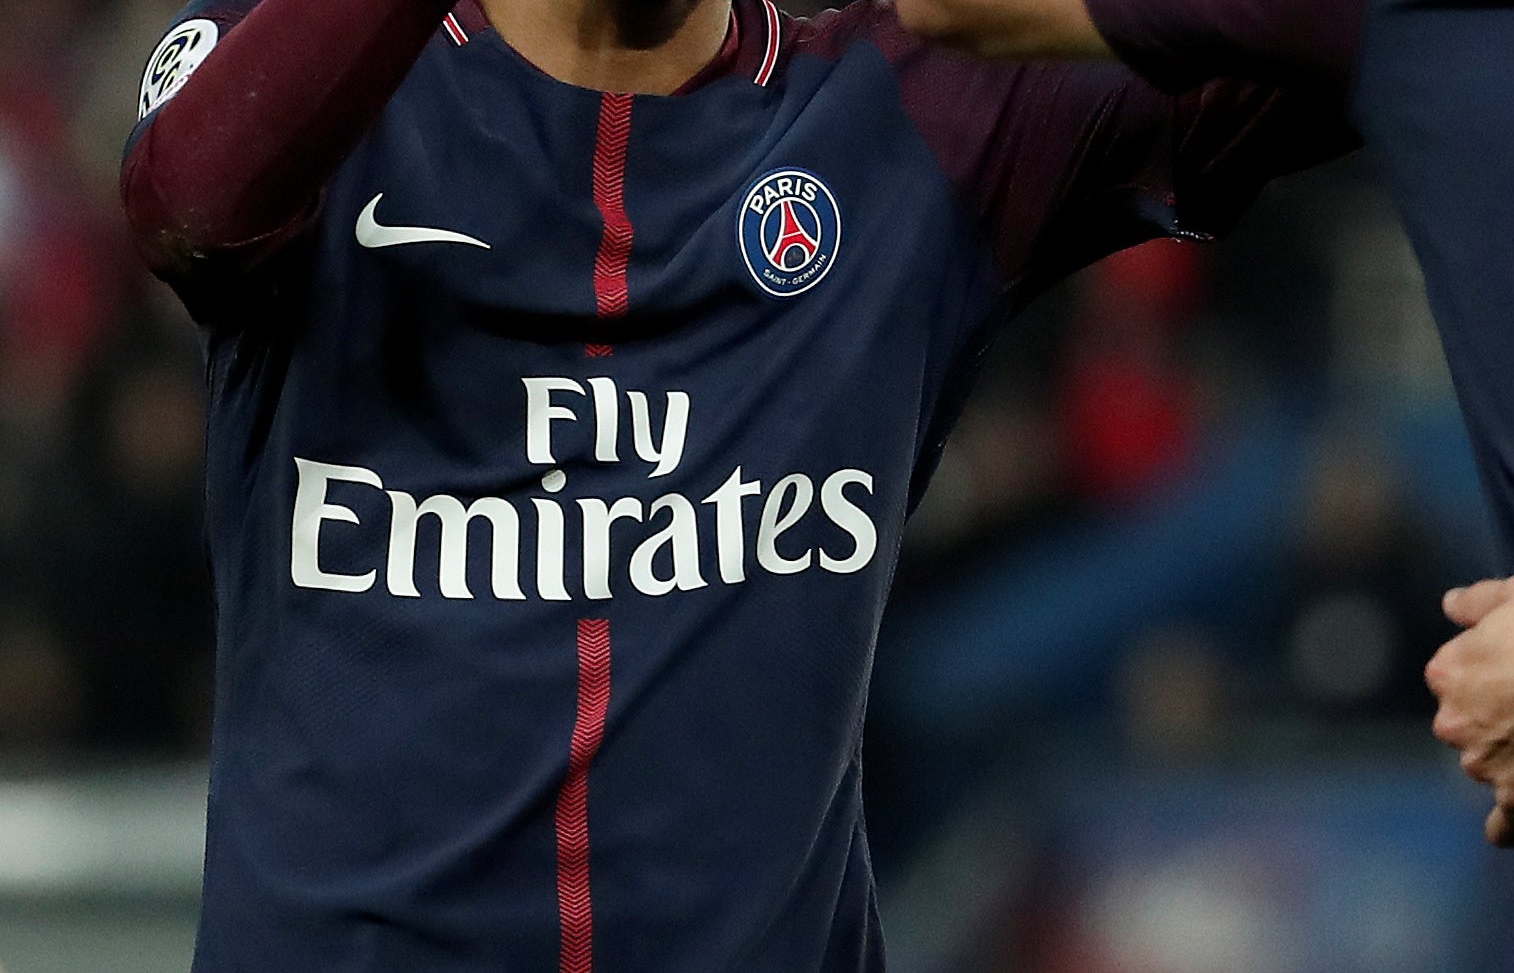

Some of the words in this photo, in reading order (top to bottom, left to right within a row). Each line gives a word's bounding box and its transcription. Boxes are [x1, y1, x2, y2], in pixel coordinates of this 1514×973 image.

[749, 177, 818, 216] PARIS
[520, 376, 691, 479] Fly
[290, 456, 878, 601] Emirates
